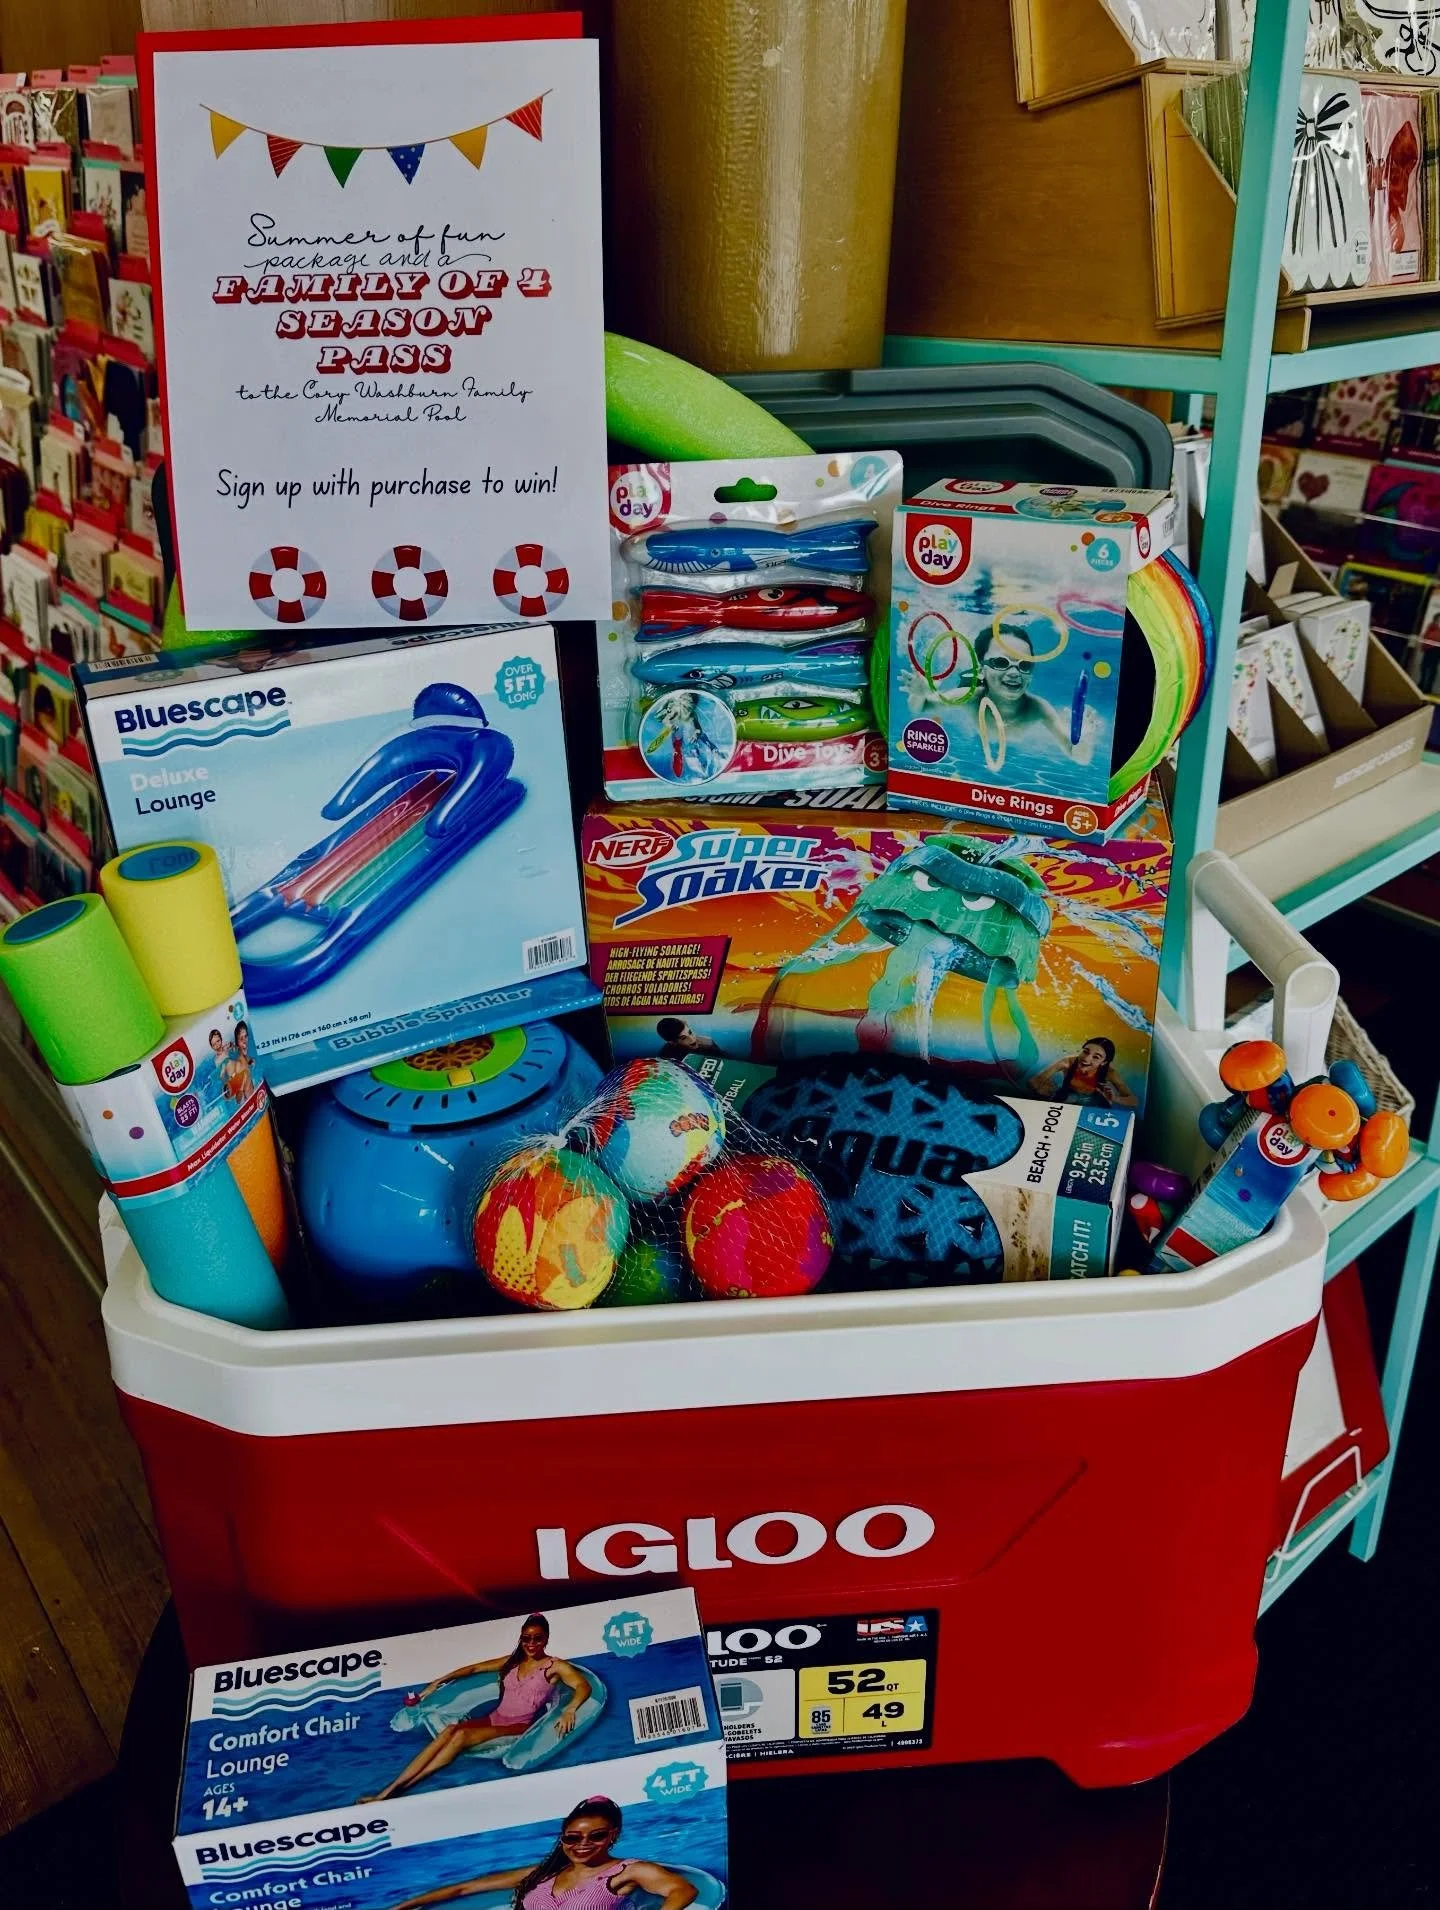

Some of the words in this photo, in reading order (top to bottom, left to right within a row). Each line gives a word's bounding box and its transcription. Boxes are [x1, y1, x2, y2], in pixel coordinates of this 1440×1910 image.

[248, 213, 391, 247] Summer
[398, 224, 434, 255] of
[439, 224, 505, 255] fun
[244, 252, 369, 274] package
[379, 250, 430, 268] and
[213, 271, 430, 304] FAMILY
[438, 269, 509, 301] OF
[517, 268, 552, 298] 4
[276, 305, 493, 339] SEASON
[316, 344, 452, 375] PASS
[303, 380, 350, 404] Cory
[354, 381, 457, 399] Washburn
[461, 376, 533, 404] Family
[315, 404, 419, 423] Memorial
[423, 404, 467, 423] Pool
[216, 469, 264, 509] Sign
[276, 480, 301, 508] up
[312, 468, 360, 495] with
[370, 467, 471, 507] purchase
[481, 466, 504, 494] to
[514, 466, 558, 494] win!
[619, 499, 653, 518] day
[920, 500, 951, 508] Dive
[957, 503, 996, 513] Rings
[919, 534, 958, 553] play
[1097, 543, 1110, 557] 6
[921, 549, 954, 569] day
[505, 664, 533, 676] OVER
[504, 679, 514, 694] 5
[516, 674, 537, 690] FT
[508, 691, 537, 704] LONG
[114, 686, 286, 733] Bluescape
[906, 740, 945, 753] SPARKLE!
[907, 729, 945, 745] RINGS
[762, 743, 807, 763] Dive
[130, 765, 209, 792] Deluxe
[136, 789, 216, 815] Lounge
[971, 788, 1005, 806] Dive
[1010, 795, 1054, 816] Rings
[1071, 816, 1092, 831] 5+
[589, 836, 673, 863] NERF
[650, 830, 820, 870] Super
[614, 861, 830, 928] Soaker
[610, 946, 659, 958] HIGH-FLYING
[659, 944, 701, 956] SOAKAGE!
[607, 959, 645, 970] ARROSAGE
[646, 959, 656, 969] DE
[655, 957, 679, 968] HAUTE
[680, 956, 707, 967] VOLTIGE
[643, 982, 692, 994] VOLADORES!
[318, 1023, 331, 1032] 160
[359, 1012, 371, 1021] cm)
[331, 1018, 419, 1050] Bubble
[425, 988, 530, 1022] Sprinkler
[170, 1066, 185, 1083] day
[1095, 1112, 1120, 1128] 5+
[1027, 1142, 1051, 1183] BEACH
[1047, 1105, 1064, 1133] POOL
[1269, 1137, 1293, 1155] day
[187, 1158, 201, 1171] Max
[1069, 1152, 1091, 1179] 9.25
[1088, 1158, 1110, 1186] 23.5
[1101, 1143, 1115, 1158] cm
[1074, 1219, 1091, 1239] IT!
[536, 1504, 935, 1580] IGLOO
[608, 1624, 620, 1638] 4
[623, 1620, 645, 1636] FT
[616, 1637, 642, 1648] WIDE
[707, 1624, 822, 1656] LOO
[213, 1649, 382, 1693] Bluescape
[711, 1657, 748, 1668] TUDE
[764, 1655, 783, 1664] 52
[828, 1668, 886, 1695] 52
[886, 1683, 899, 1691] QT
[811, 1710, 831, 1723] 85
[862, 1702, 905, 1719] 49
[209, 1723, 299, 1752] Comfort
[304, 1712, 361, 1737] Chair
[724, 1729, 762, 1737] -GOBELETS
[207, 1752, 289, 1779] Lounge
[651, 1773, 667, 1788] 4
[671, 1769, 701, 1785] FT
[203, 1783, 235, 1796] AGES
[660, 1784, 692, 1795] WIDE
[202, 1796, 249, 1821] 14+
[195, 1819, 389, 1865] Bluescape
[209, 1878, 308, 1904] Comfort
[312, 1866, 372, 1886] Chair
